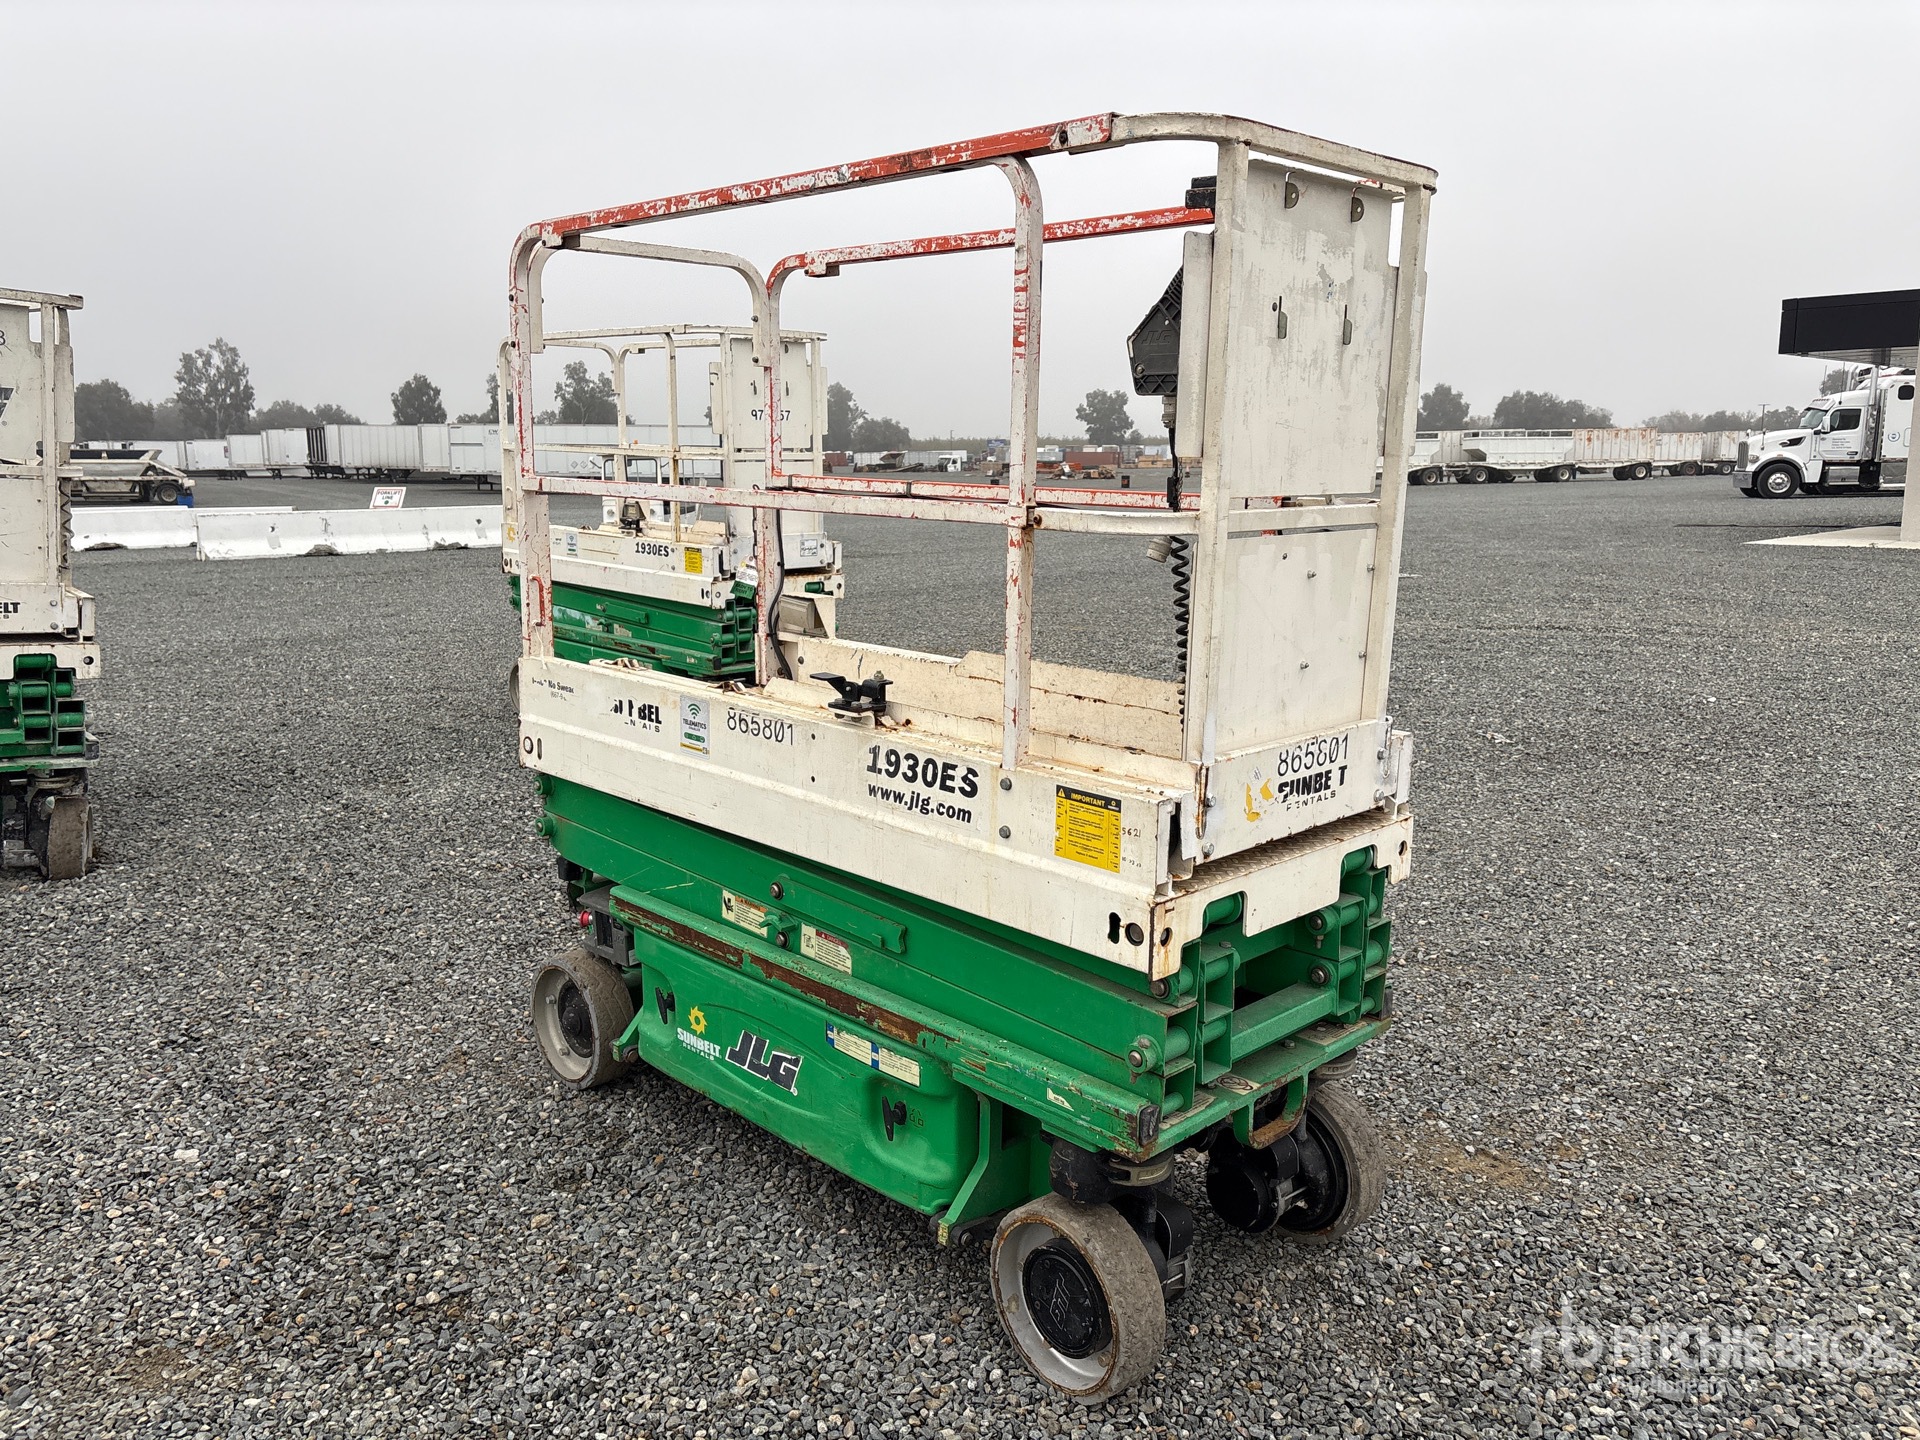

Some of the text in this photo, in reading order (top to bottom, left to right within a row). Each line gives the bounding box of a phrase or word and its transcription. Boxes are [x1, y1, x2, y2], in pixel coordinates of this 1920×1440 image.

[751, 409, 791, 421] 9757
[635, 541, 670, 558] 1930ES
[727, 707, 794, 746] 865801
[866, 745, 980, 799] 1930ES
[1277, 733, 1349, 777] 865801
[868, 784, 972, 824] www.jlg.com
[1070, 792, 1106, 808] IMPORTANT
[1277, 765, 1348, 804] SUNBET
[677, 1028, 721, 1059] SUNBELT
[683, 1042, 715, 1061] RENTALS
[725, 1030, 803, 1096] JLG
